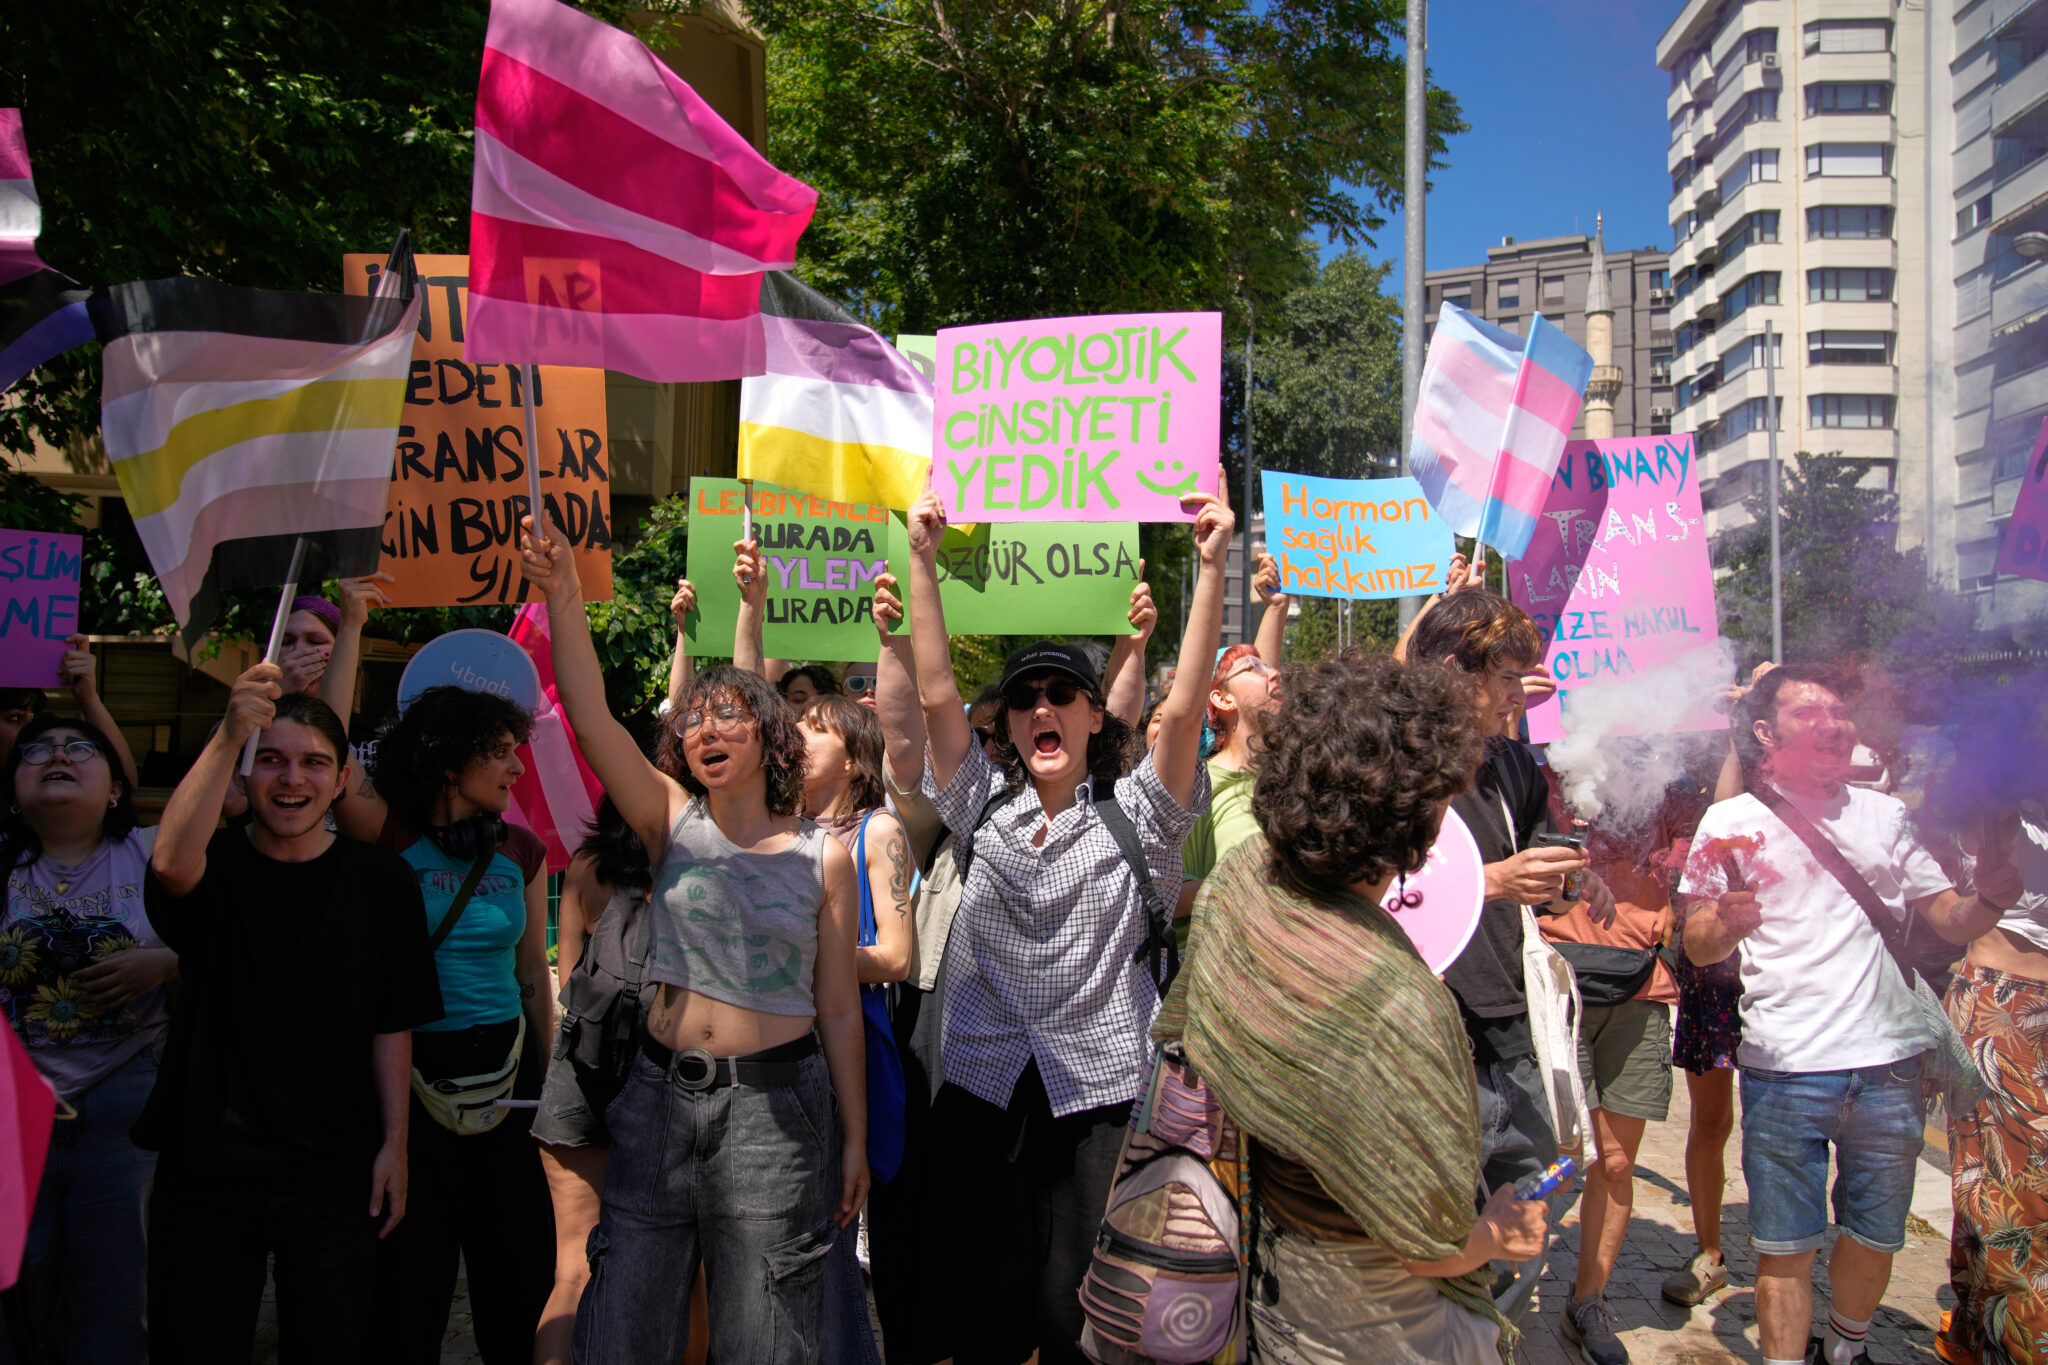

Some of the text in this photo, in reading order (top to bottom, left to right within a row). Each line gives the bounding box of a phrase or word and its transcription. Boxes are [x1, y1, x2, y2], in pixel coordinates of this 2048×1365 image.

[952, 326, 1197, 394] BİYOLOJİK
[944, 391, 1172, 450] CİNSİYETİ
[946, 447, 1121, 512] YEDİK
[1586, 438, 1690, 496] BINARY
[697, 487, 889, 525] LEZBİYENLE
[1281, 483, 1429, 522] Hormon
[1046, 541, 1139, 580] OLSA
[1281, 523, 1378, 564] sağlık
[1281, 552, 1439, 595] hakkımız
[1524, 562, 1620, 604] LARIN
